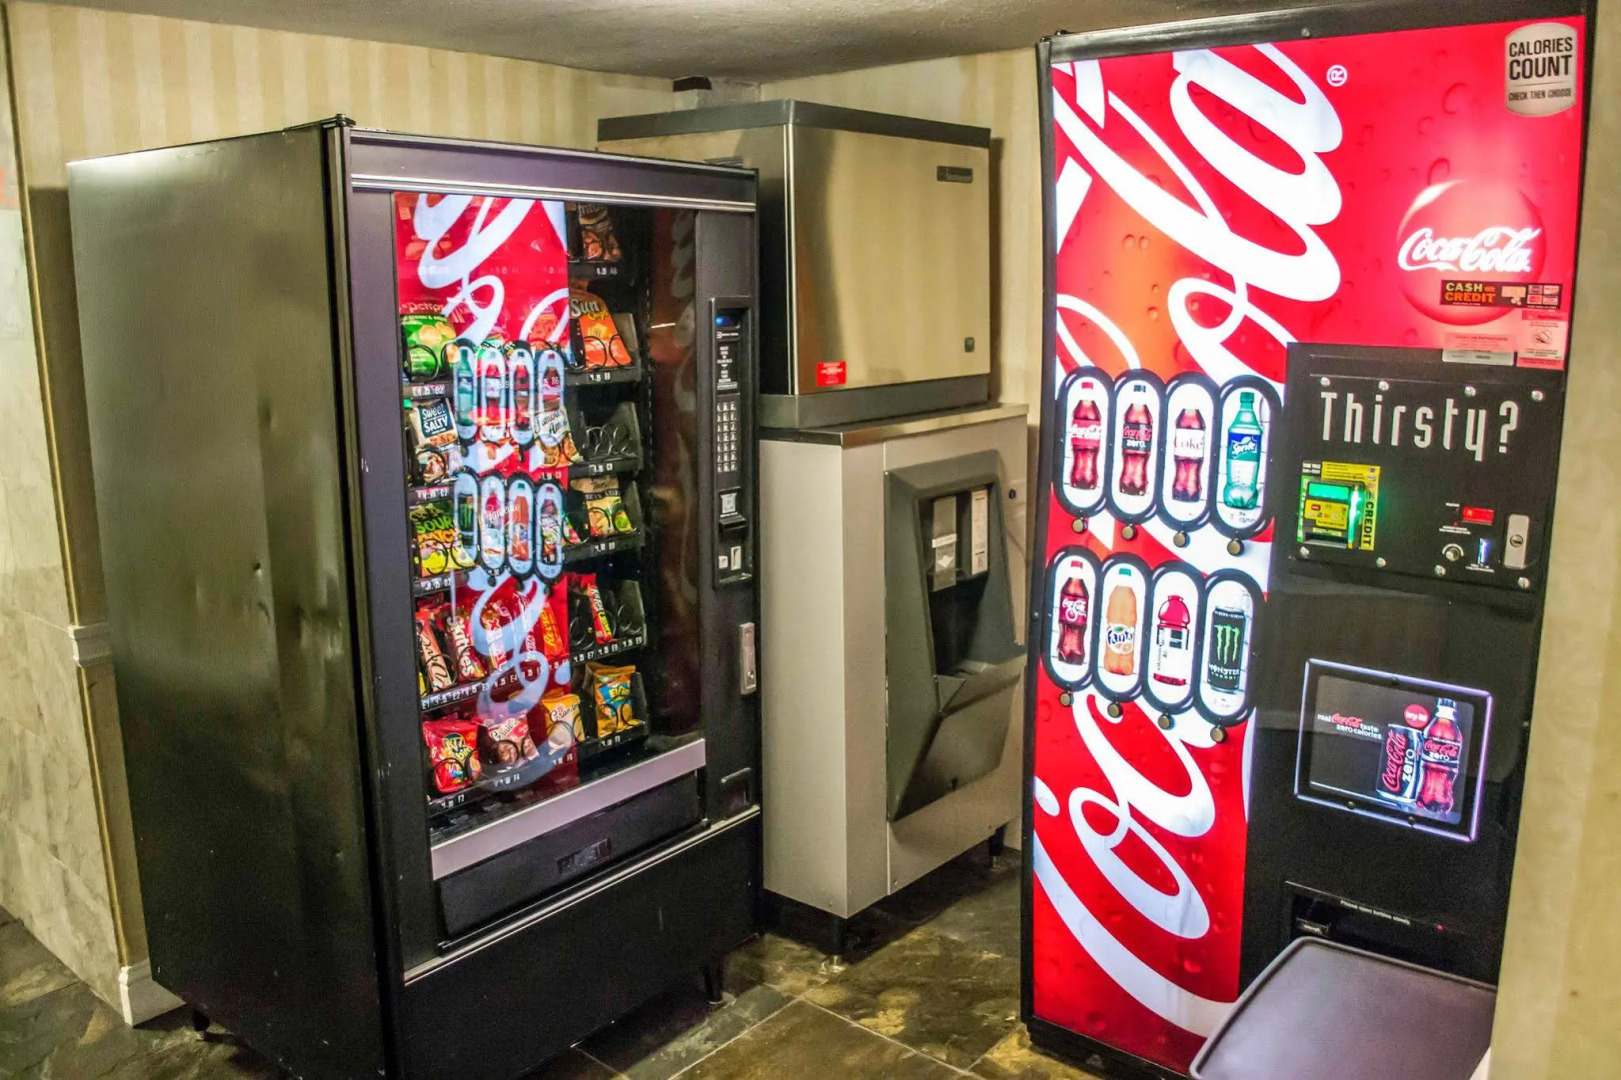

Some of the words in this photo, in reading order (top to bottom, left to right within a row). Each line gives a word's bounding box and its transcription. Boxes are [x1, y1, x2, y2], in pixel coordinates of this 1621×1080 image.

[1509, 37, 1573, 57] CALORIES
[1509, 55, 1573, 80] COUNT
[1508, 92, 1528, 101] CHECK
[1530, 90, 1546, 99] THEN
[1547, 88, 1572, 98] CHOOSE
[1444, 292, 1496, 303] CREDIT
[570, 298, 599, 318] Sun
[422, 402, 446, 420] Sweet
[424, 416, 448, 433] SALTY
[1320, 391, 1519, 462] Thirsty?
[1231, 441, 1257, 456] Sprite
[414, 515, 454, 534] SOUR
[1363, 501, 1375, 546] CREDIT
[1336, 724, 1353, 733] zero
[1353, 728, 1383, 740] calories
[1360, 723, 1379, 732] taste
[1402, 749, 1416, 782] zero
[1429, 751, 1450, 762] zero
